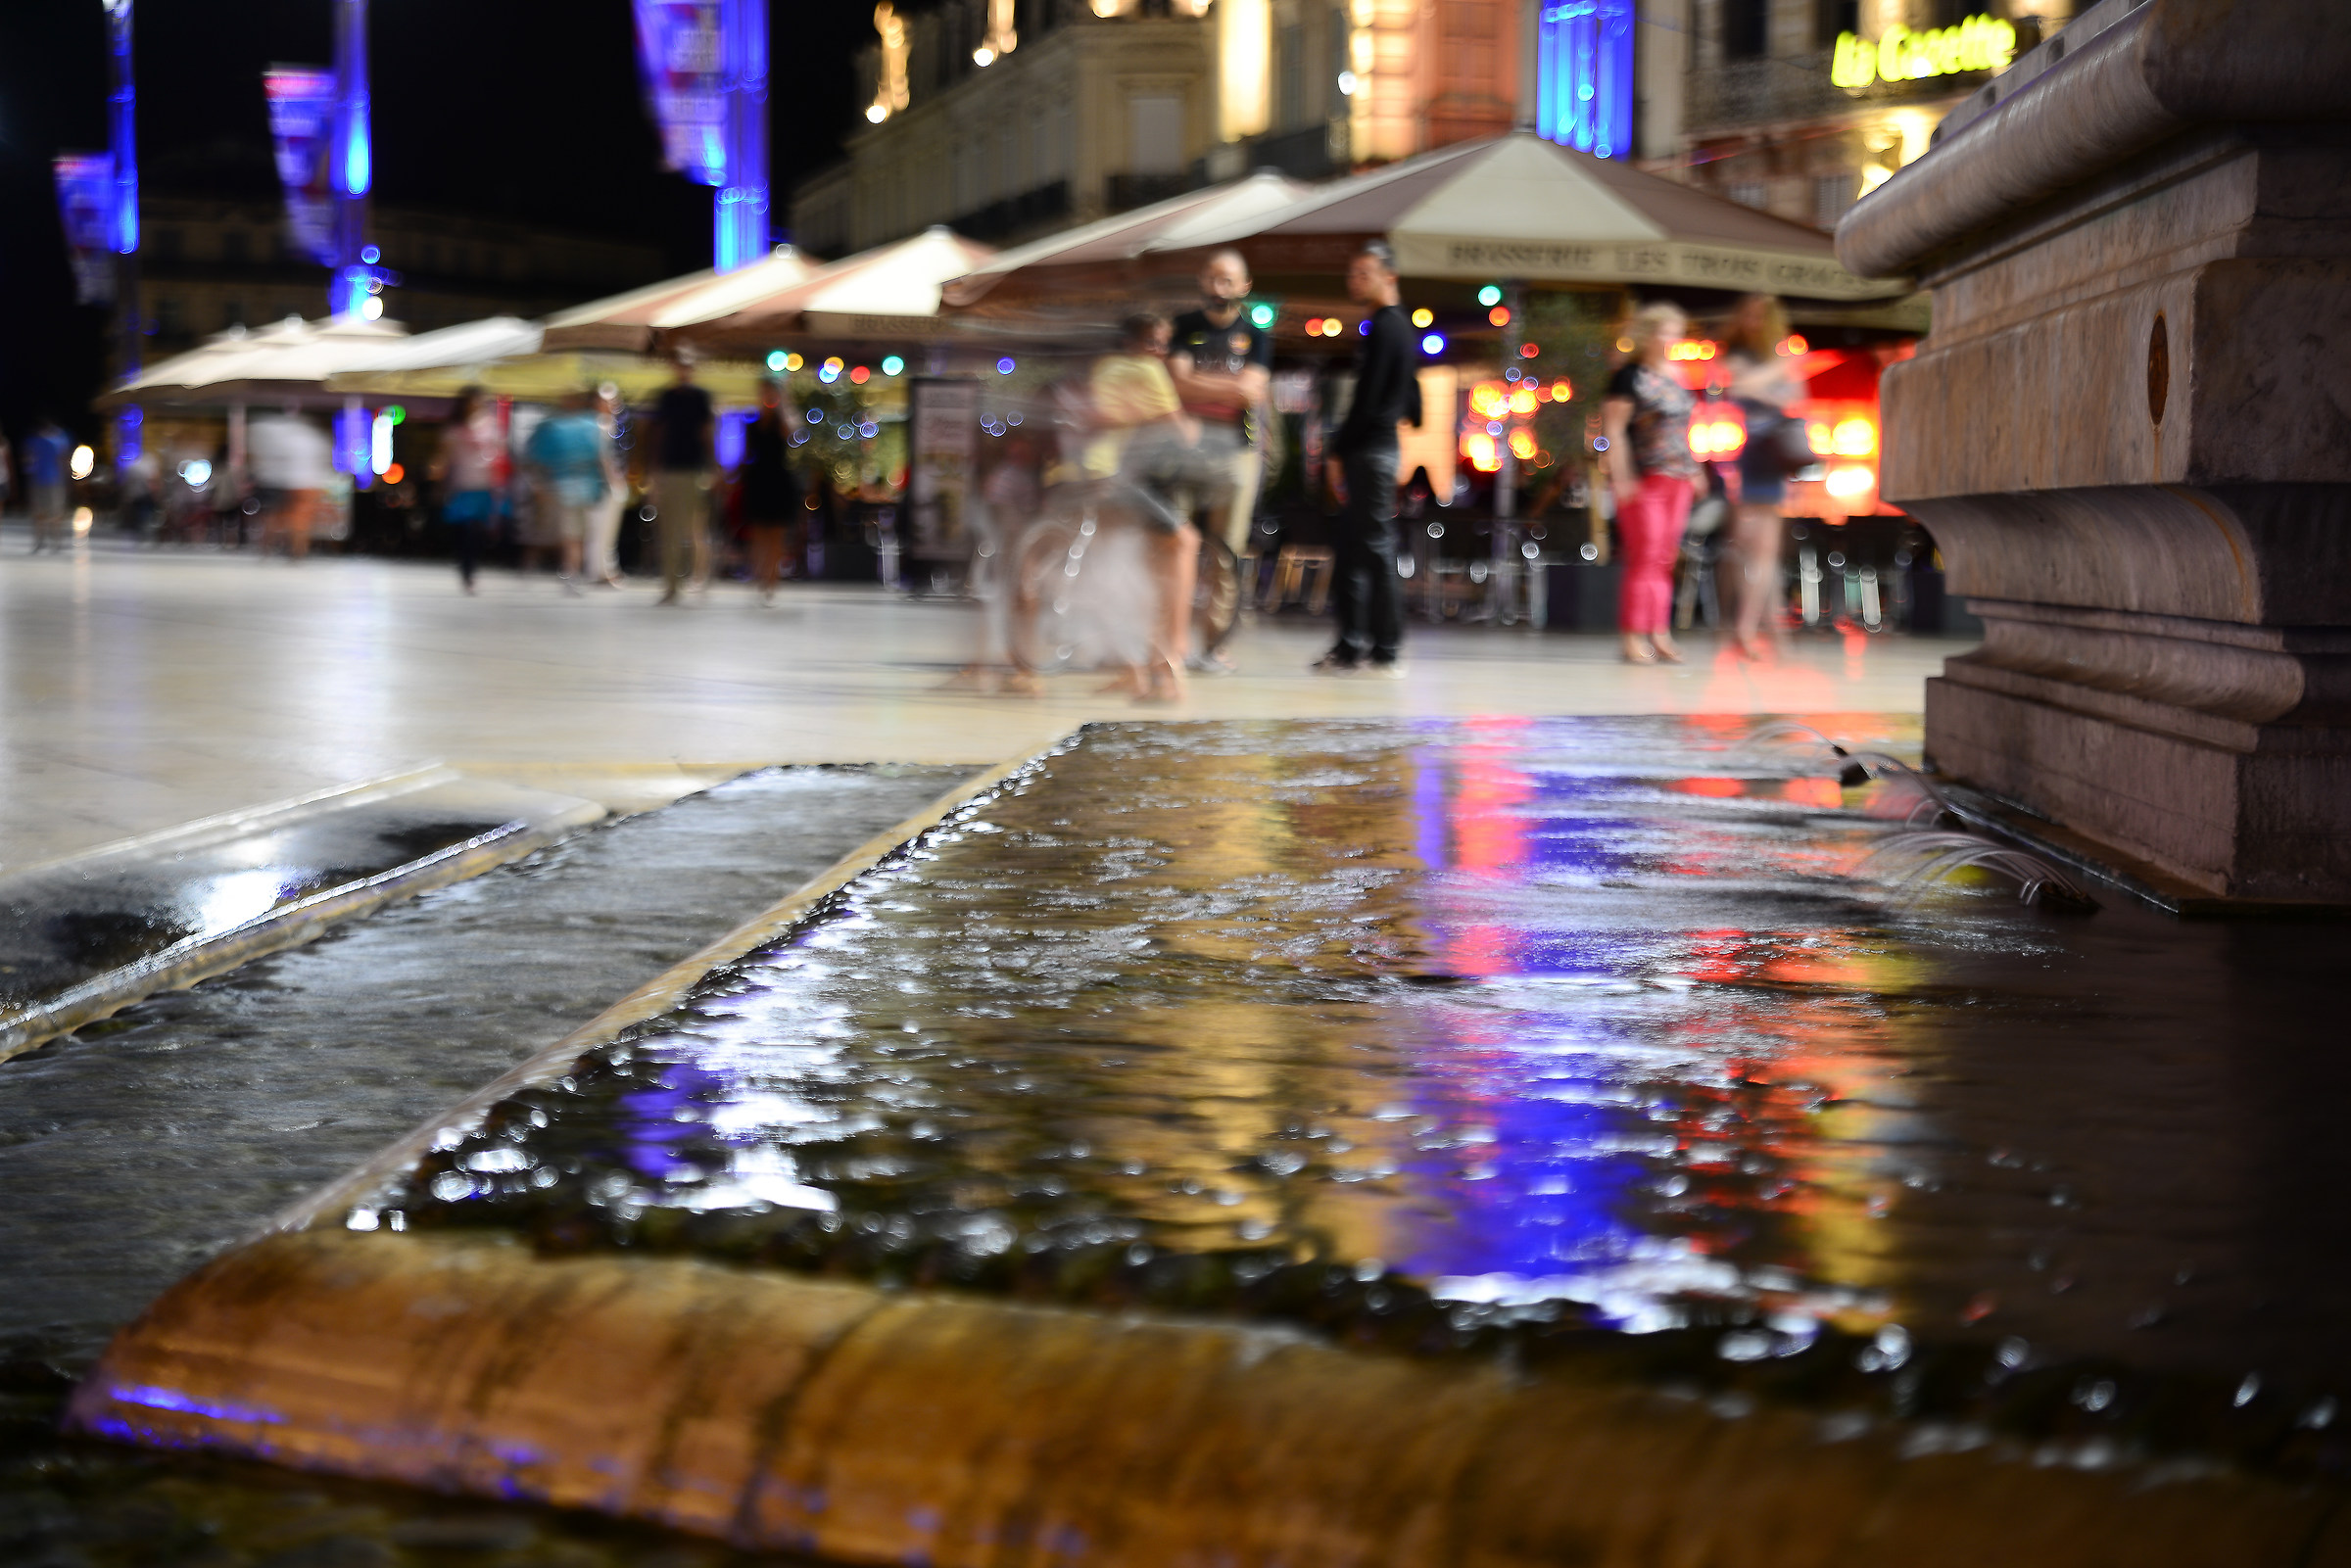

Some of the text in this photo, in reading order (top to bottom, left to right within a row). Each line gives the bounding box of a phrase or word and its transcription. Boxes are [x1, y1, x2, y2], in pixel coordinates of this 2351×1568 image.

[1448, 241, 1596, 270] BRASSERIE
[1614, 248, 1668, 274] LES
[1680, 251, 1760, 282] TROIS
